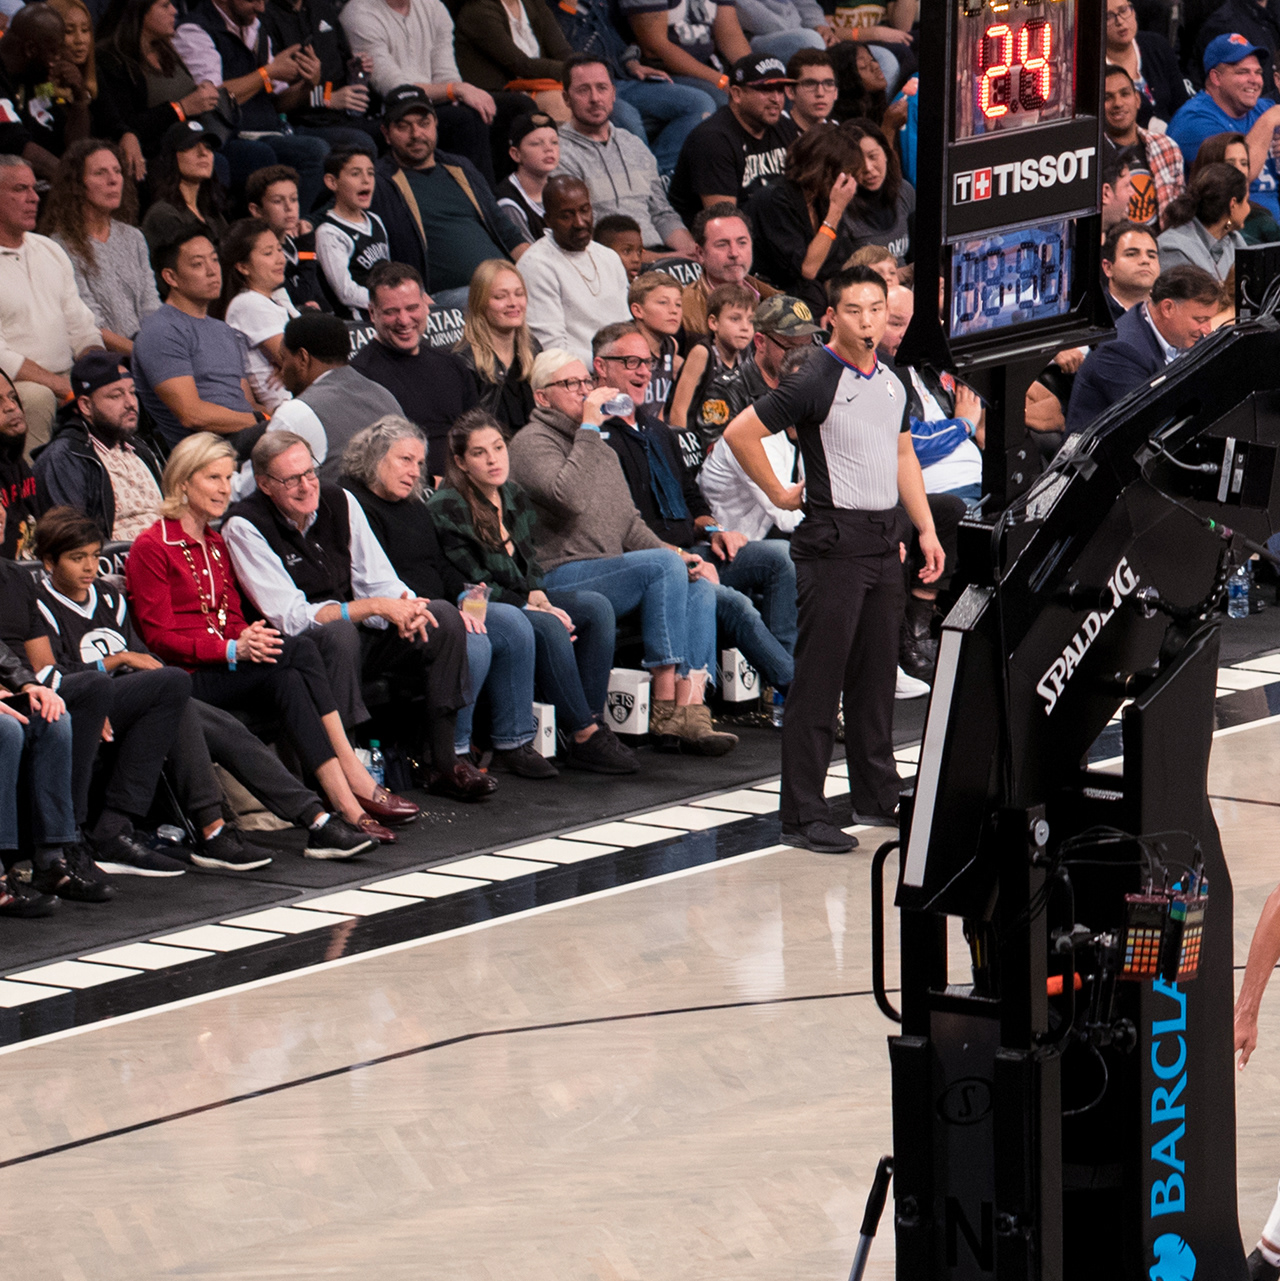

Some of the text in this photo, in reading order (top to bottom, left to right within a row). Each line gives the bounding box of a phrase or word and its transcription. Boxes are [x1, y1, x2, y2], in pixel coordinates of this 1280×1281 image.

[981, 23, 1050, 118] 24
[994, 147, 1096, 196] TISSOT
[654, 261, 703, 288] ATAR
[423, 308, 467, 339] ATAR
[431, 328, 465, 348] AIRWAY
[1150, 972, 1188, 1218] BARCLA
